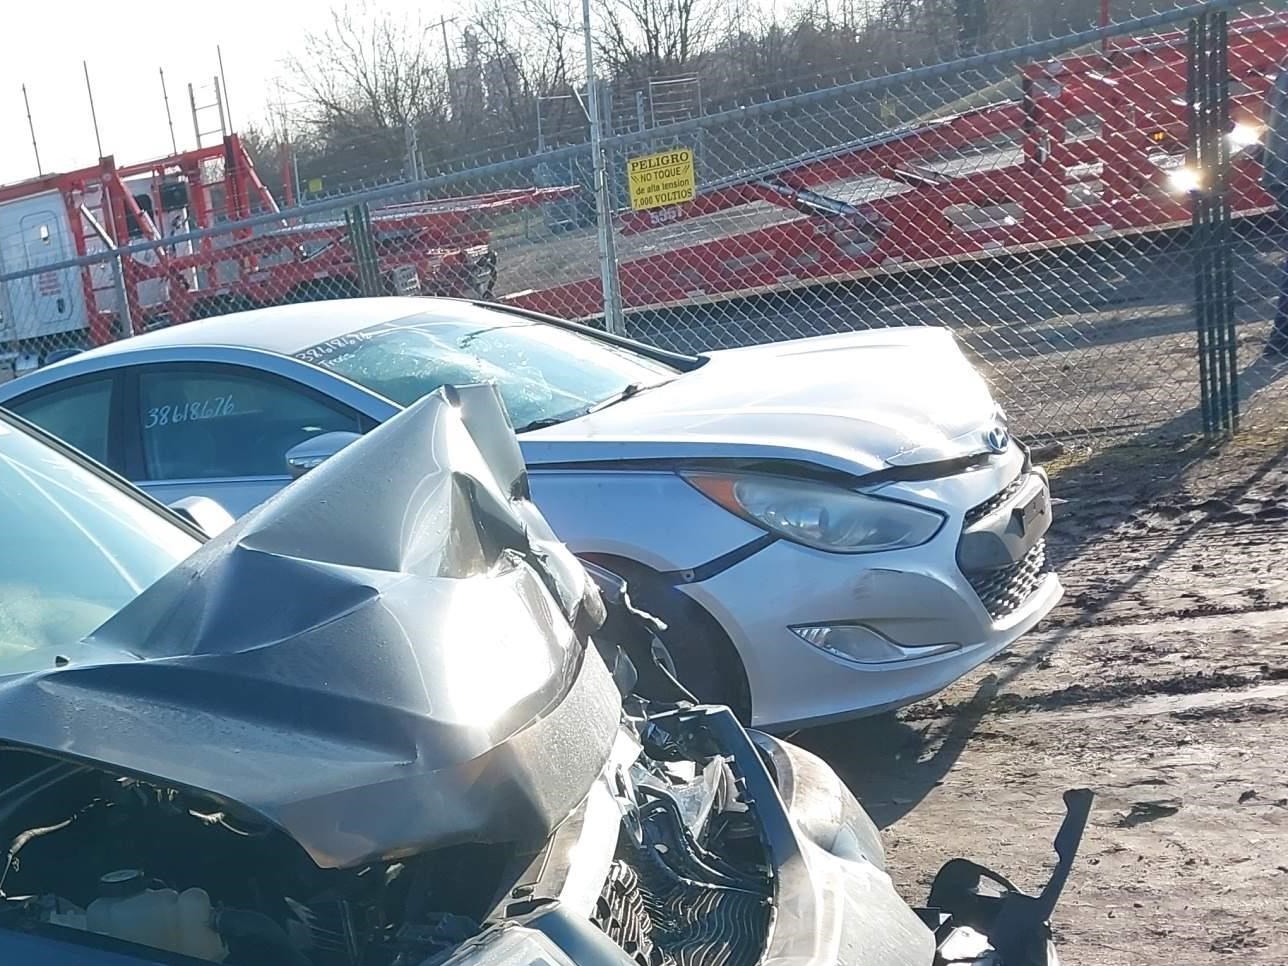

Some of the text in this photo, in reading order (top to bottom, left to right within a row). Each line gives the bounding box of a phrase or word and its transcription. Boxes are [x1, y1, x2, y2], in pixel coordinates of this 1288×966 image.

[631, 152, 689, 171] PELIGRO
[640, 168, 682, 183] NO TOQUE
[635, 179, 690, 195] de alta tension
[634, 188, 693, 209] 7,000 VOLTIOS
[144, 394, 235, 428] 38618676
